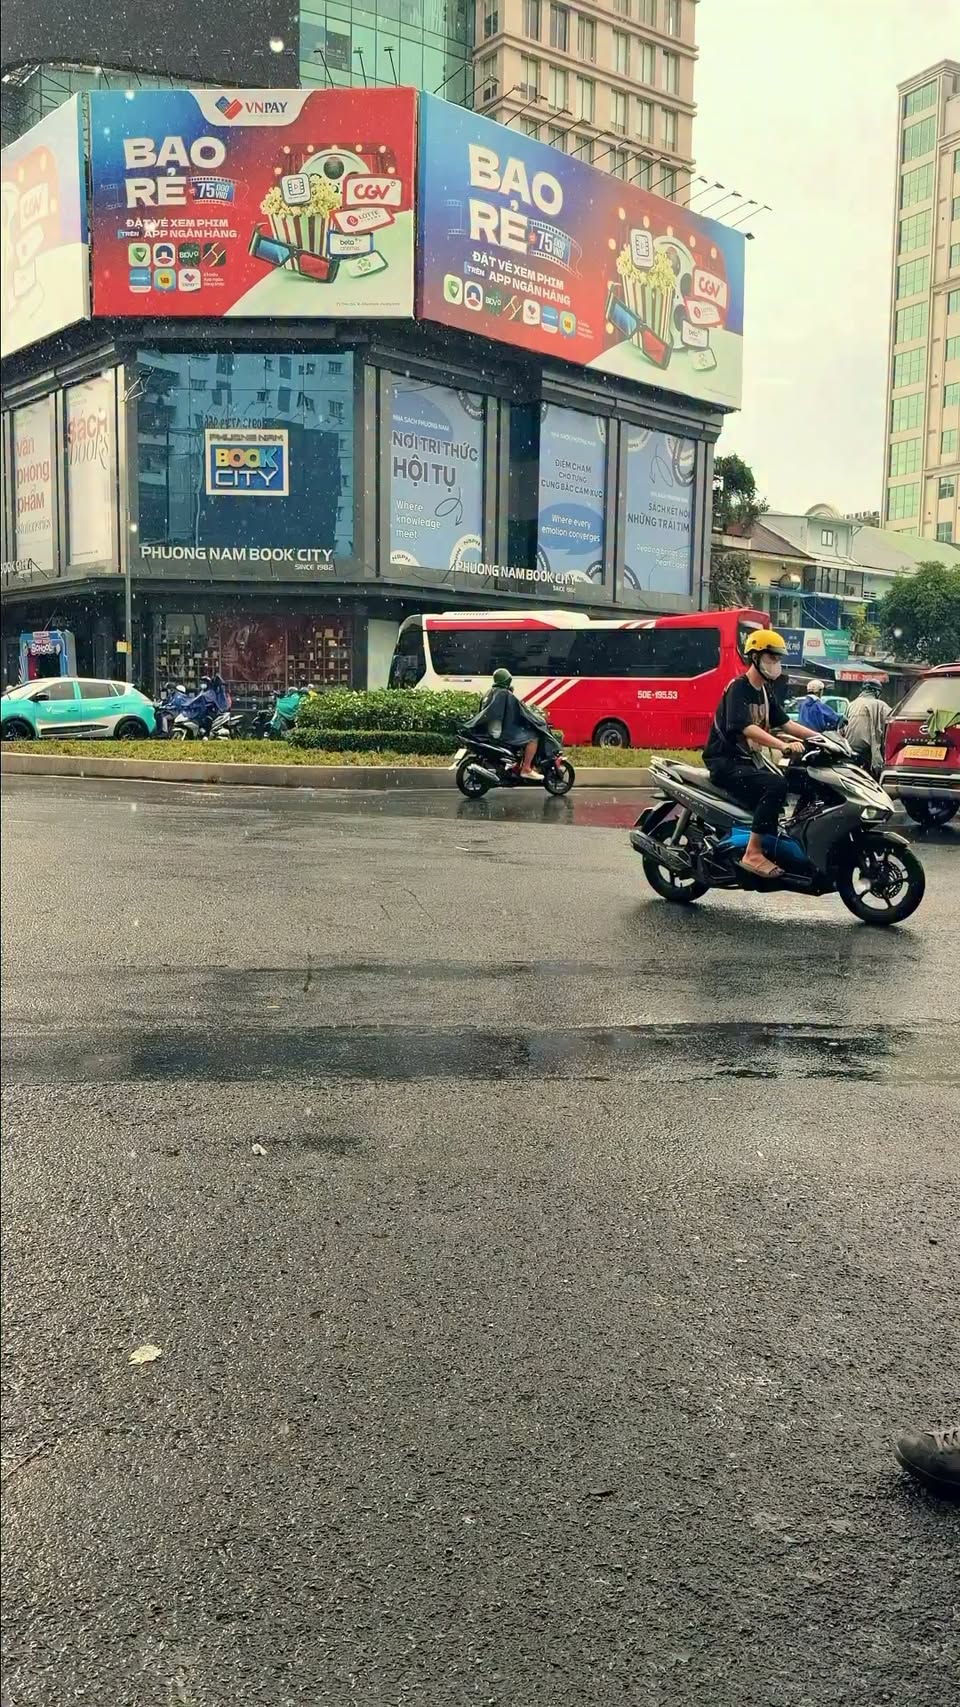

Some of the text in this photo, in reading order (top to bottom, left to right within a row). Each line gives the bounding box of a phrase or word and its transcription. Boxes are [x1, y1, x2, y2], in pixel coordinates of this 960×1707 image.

[245, 102, 288, 113] VNPAY
[123, 136, 226, 170] BAO
[125, 167, 187, 208] RẺ
[468, 143, 564, 216] BAO
[197, 183, 216, 198] 75
[354, 183, 390, 200] CGV
[152, 217, 169, 228] VÉ
[170, 219, 197, 228] XEM
[199, 219, 229, 228] PHIM
[358, 210, 379, 220] LOTTE
[121, 229, 140, 237] TRÊN
[144, 229, 168, 238] APP
[204, 229, 238, 238] HÀNG
[469, 198, 528, 255] RẺ
[537, 230, 553, 253] 75
[472, 250, 565, 290] ĐẶT VÉ XEM PHIM
[467, 265, 485, 277] TRÊN
[489, 271, 511, 286] APP
[542, 287, 571, 306] HÀNG
[698, 276, 721, 298] CGV
[392, 430, 479, 462] NƠI TRI THỨC
[215, 447, 278, 468] BOOK
[215, 470, 279, 486] CITY
[393, 454, 456, 493] HỘI TỤ
[396, 499, 424, 512] Where
[396, 513, 441, 530] knowledge
[551, 513, 592, 530] Where every
[396, 529, 418, 539] meet
[541, 525, 601, 543] emotion converges
[140, 546, 334, 562] PHUONG NAM BOOK CITY
[294, 563, 315, 571] SINCE
[456, 560, 576, 586] PHUONG NAM BOOK CITY
[31, 643, 53, 654] SCHOOL
